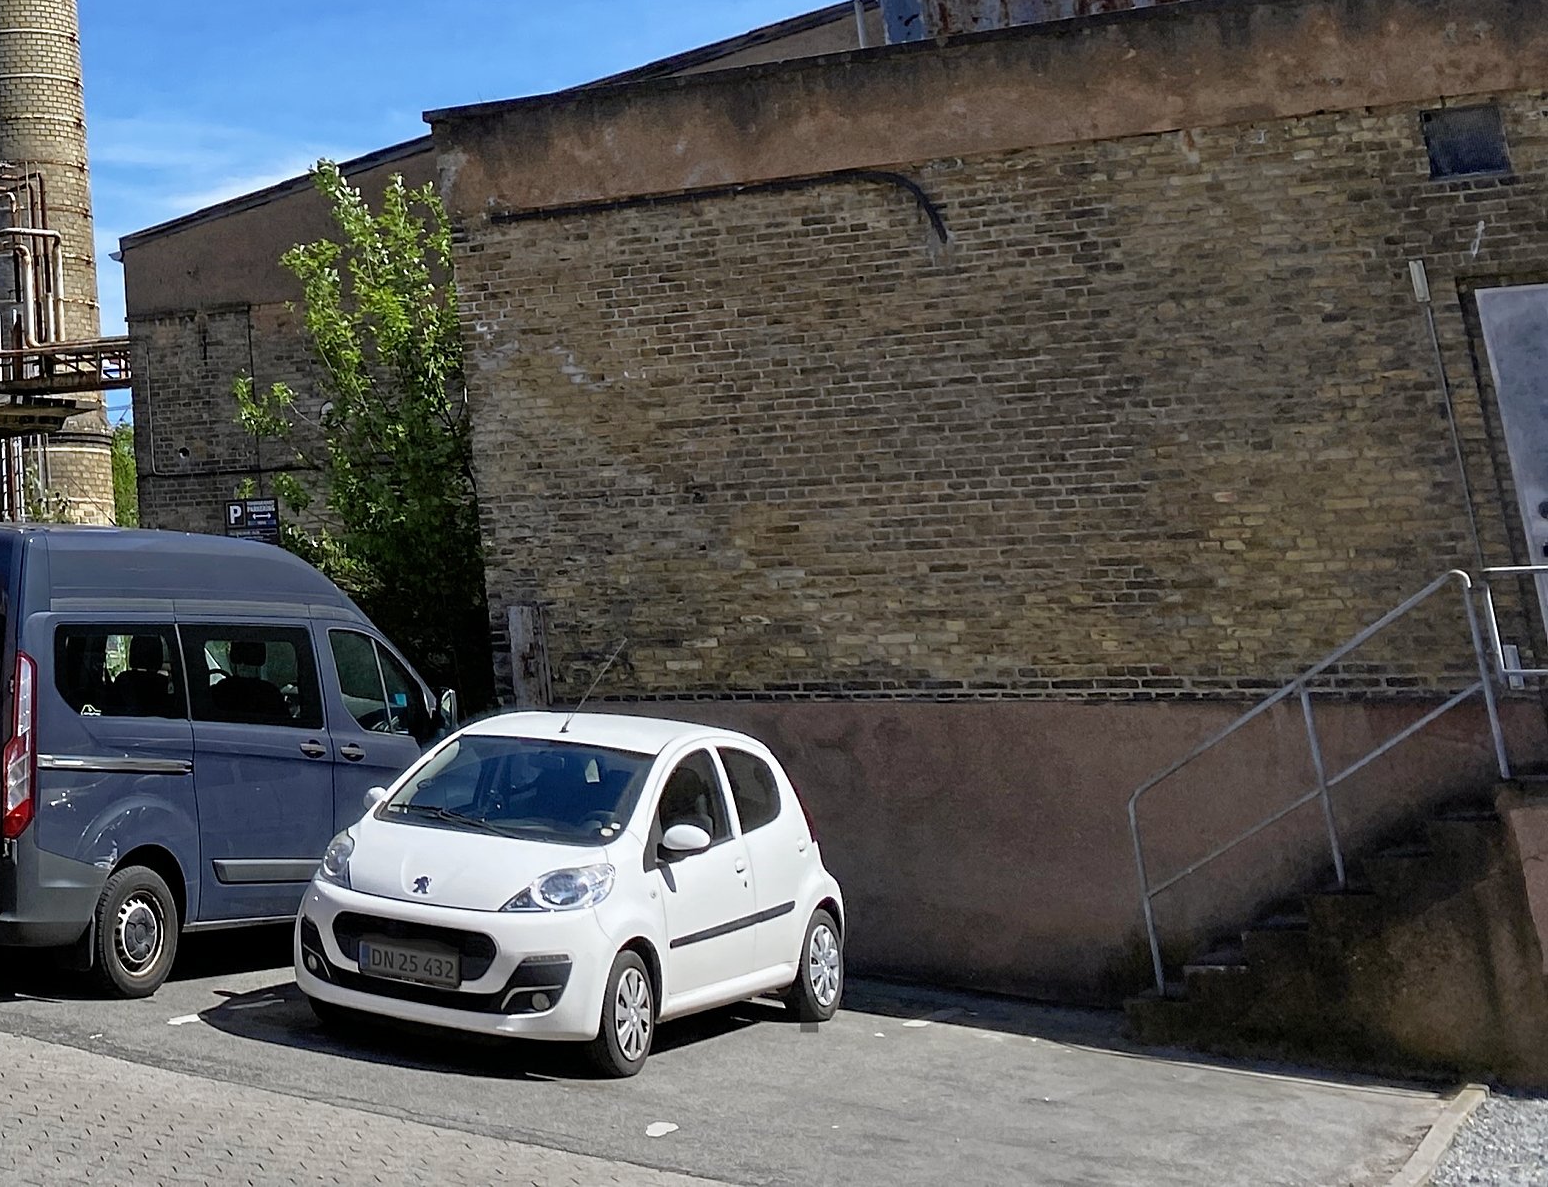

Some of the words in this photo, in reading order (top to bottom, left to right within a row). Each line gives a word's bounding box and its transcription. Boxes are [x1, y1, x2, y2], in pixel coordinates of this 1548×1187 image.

[229, 505, 242, 524] P
[372, 948, 395, 969] DN
[398, 953, 419, 973] 25
[423, 957, 455, 980] 432
